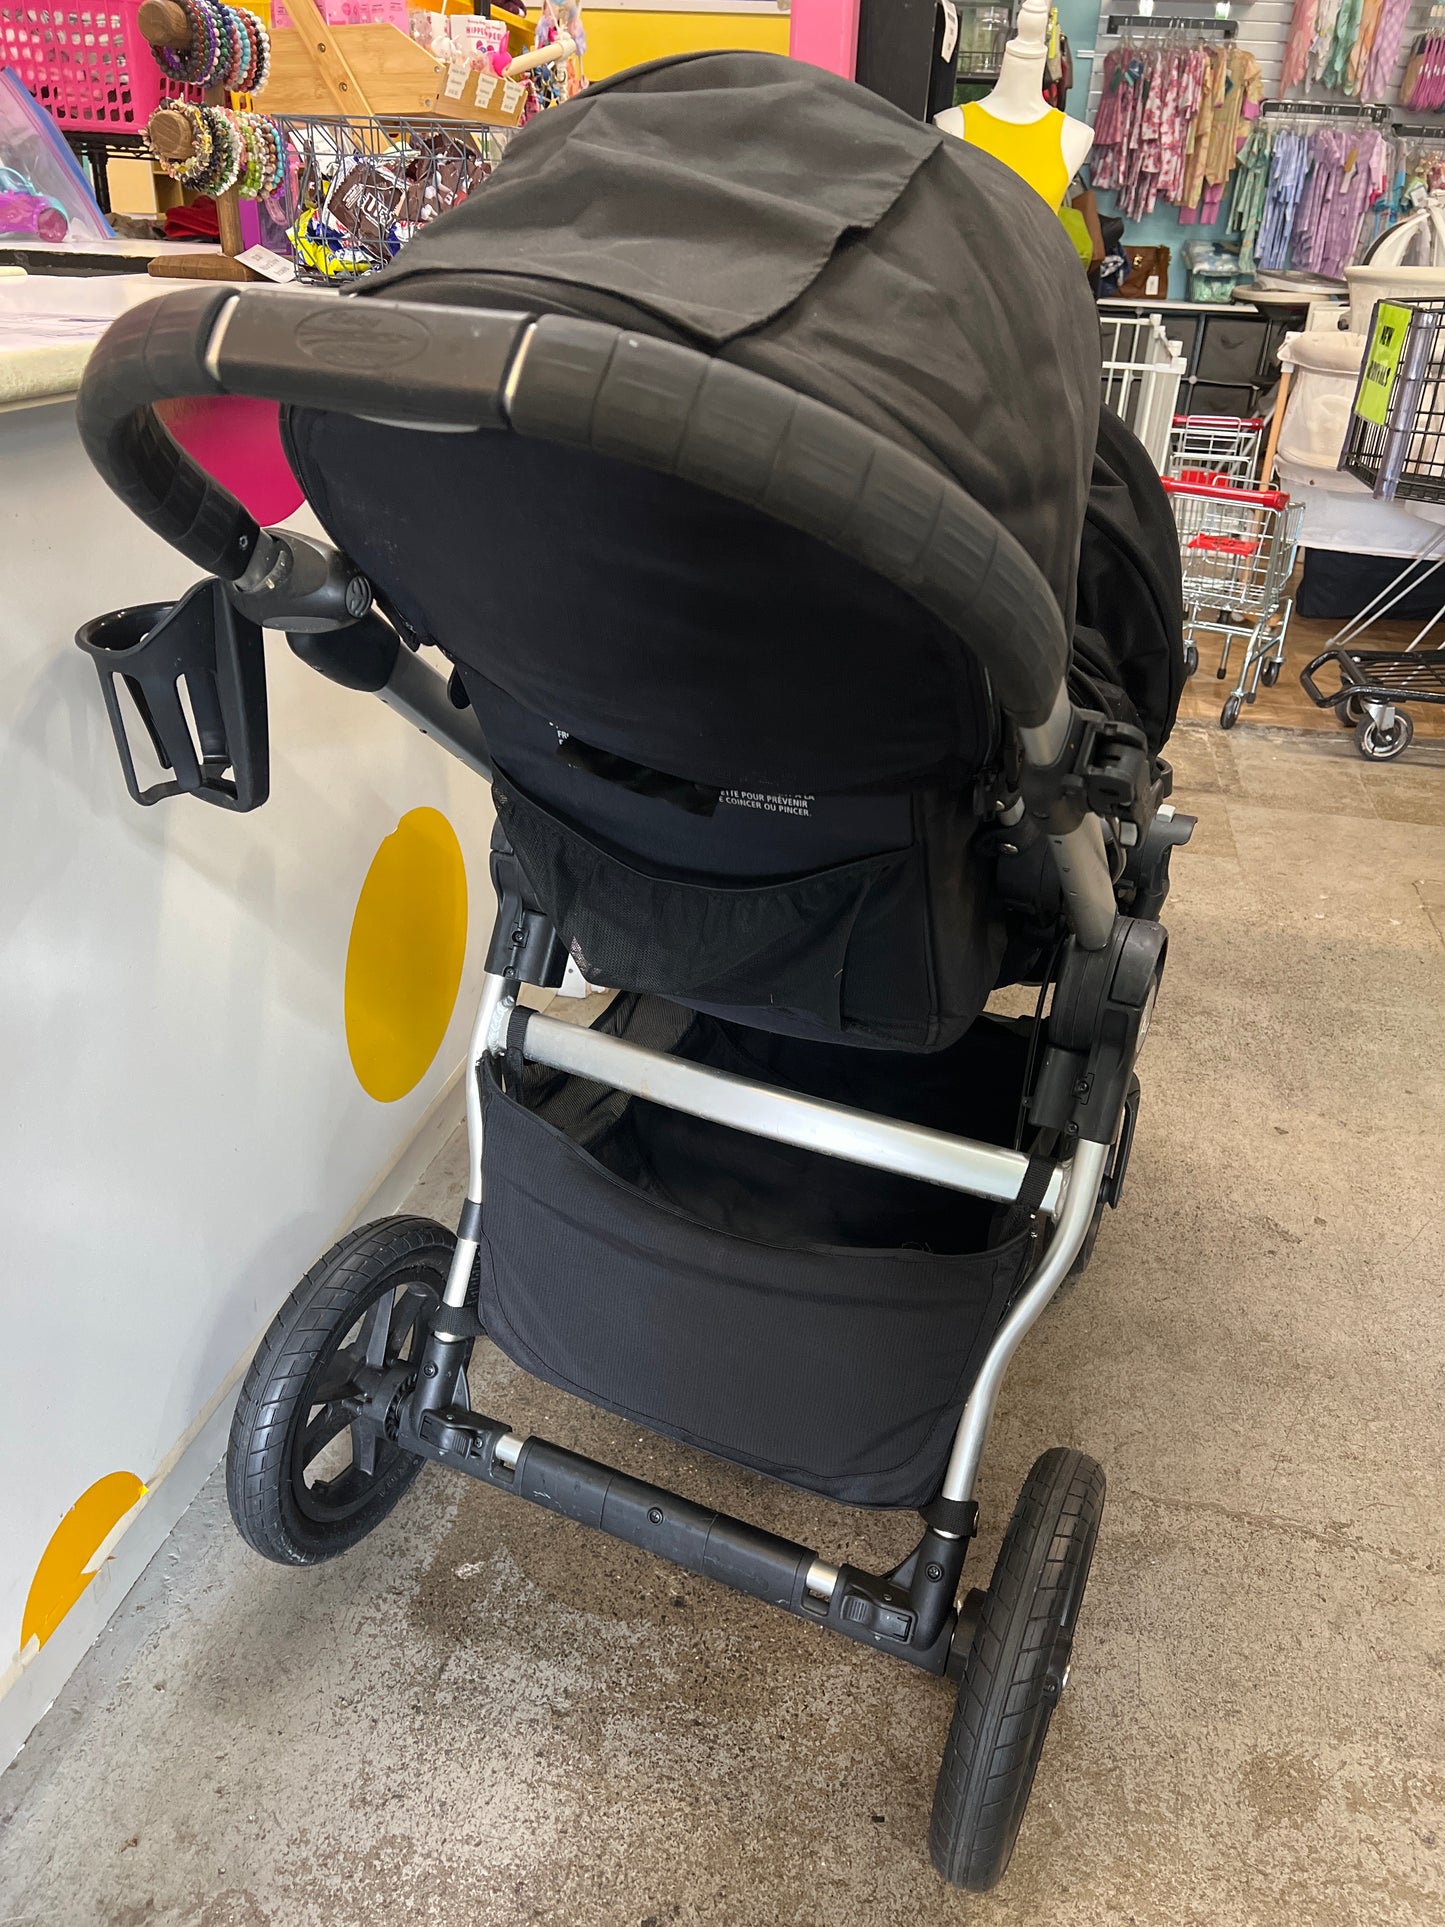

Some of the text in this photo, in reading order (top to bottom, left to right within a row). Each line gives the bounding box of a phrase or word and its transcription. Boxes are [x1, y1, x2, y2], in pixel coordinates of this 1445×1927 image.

[725, 797, 762, 808] COINCER
[763, 803, 776, 811] OU
[778, 806, 812, 816] PINCER.
[741, 791, 765, 801] POUR
[766, 794, 808, 808] PRÉVENIR
